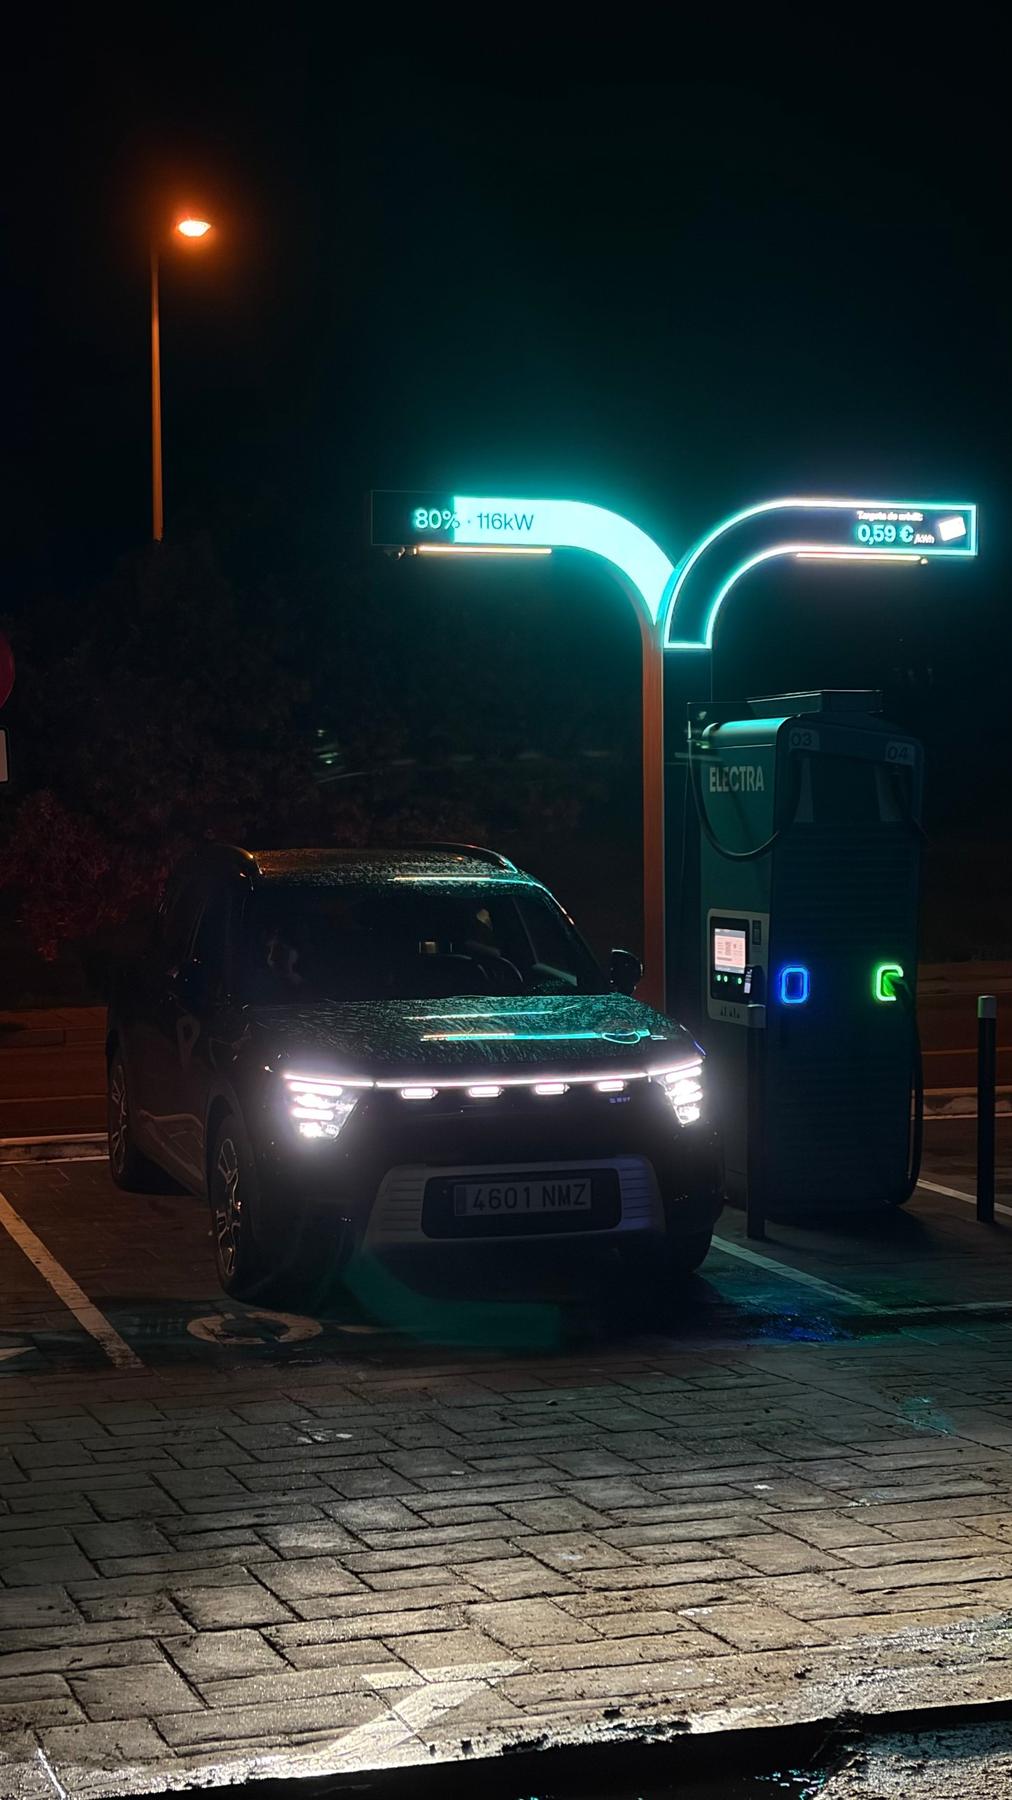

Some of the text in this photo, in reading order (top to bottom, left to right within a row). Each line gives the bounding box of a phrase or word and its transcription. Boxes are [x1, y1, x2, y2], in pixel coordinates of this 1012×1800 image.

[414, 508, 460, 529] 80%
[476, 512, 534, 531] 116kW
[857, 524, 896, 544] 0,59
[899, 524, 914, 542] €
[791, 732, 813, 746] 03
[887, 745, 909, 760] 04
[709, 765, 764, 792] ELECTRA
[472, 1183, 586, 1211] 4601 NMZ
